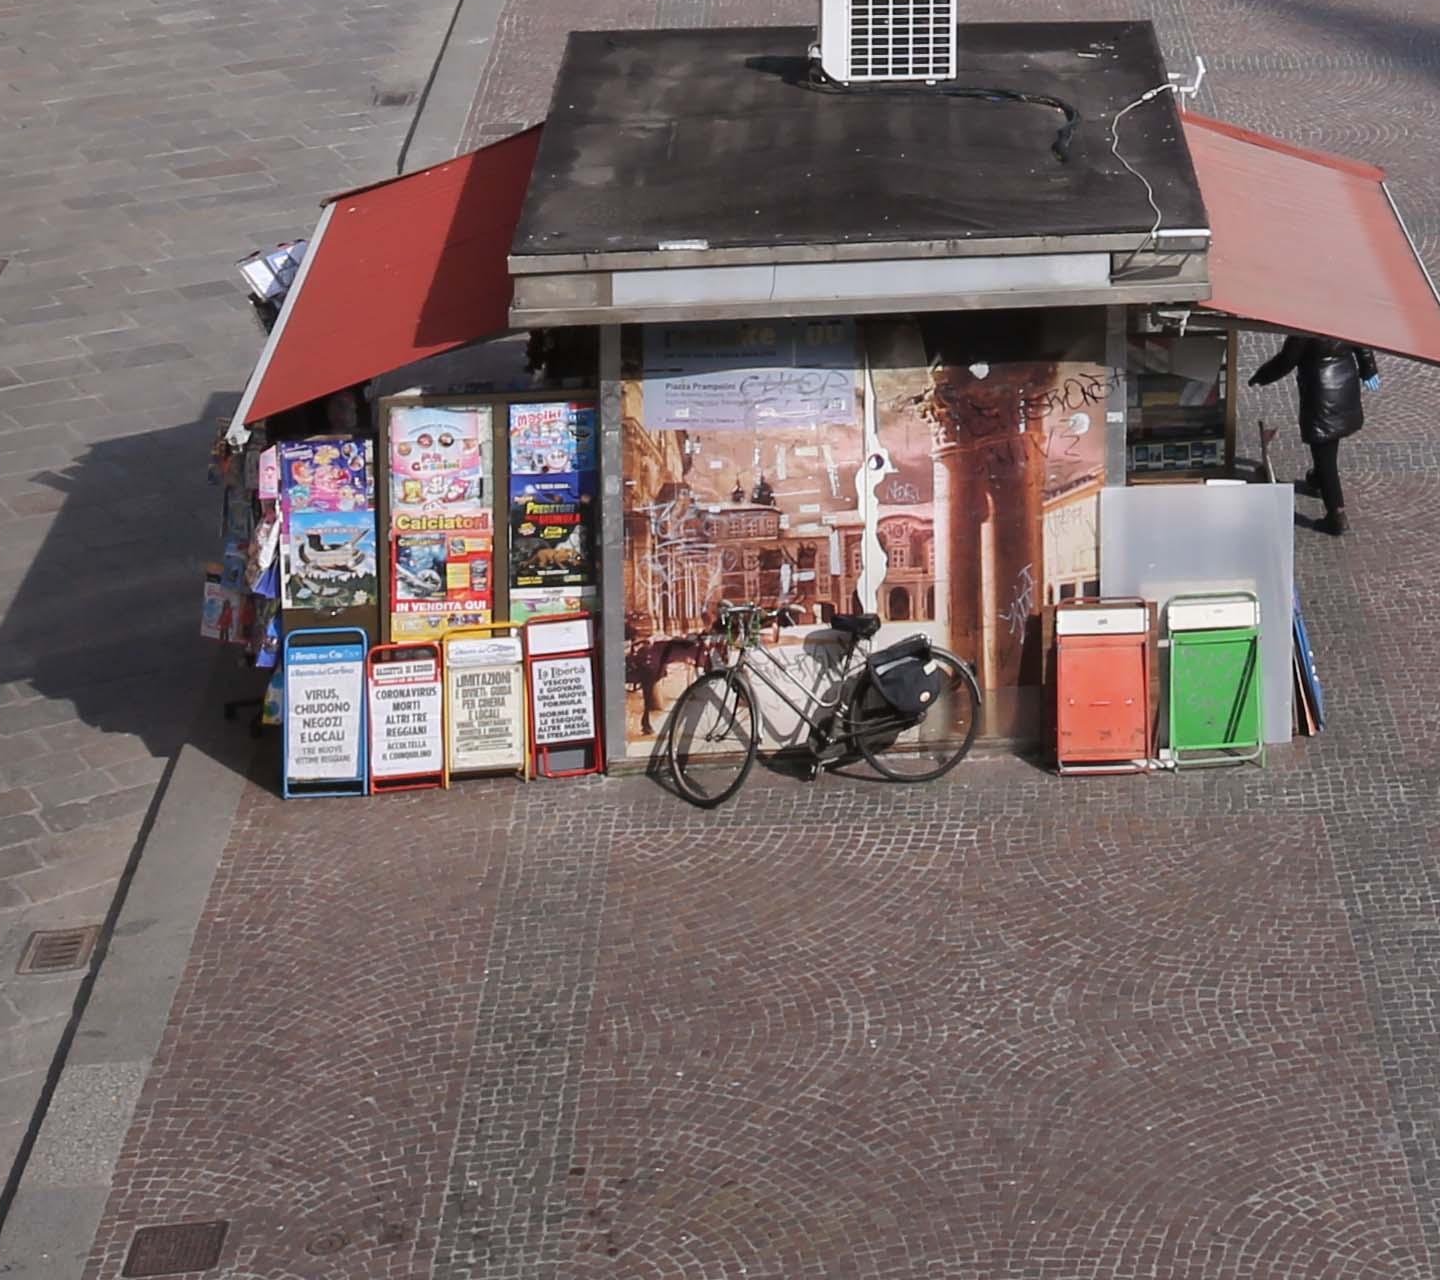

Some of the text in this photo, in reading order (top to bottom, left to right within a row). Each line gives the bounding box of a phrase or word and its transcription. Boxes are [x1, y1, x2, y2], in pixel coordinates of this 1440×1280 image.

[397, 600, 486, 612] IN VENDITA QUI
[456, 671, 511, 688] LIMITAZIONI
[543, 677, 581, 686] VESCOVO
[305, 688, 339, 700] VIRUS,
[376, 686, 436, 700] CORONAVIRUS
[558, 691, 586, 699] NUOVA
[295, 702, 350, 715] CHIUDONO
[392, 701, 420, 711] MORTI
[462, 697, 505, 710] PER CINEMA
[543, 699, 582, 707] FORMULA
[386, 712, 427, 724] ALTRI TRE
[474, 708, 500, 720] LOCALI
[539, 710, 569, 718] NORME
[303, 716, 342, 729] NEGOZI
[564, 721, 589, 729] MESSE
[300, 730, 345, 743] E LOCALI
[386, 725, 427, 737] REGGIANI
[546, 729, 591, 739] STREAMING
